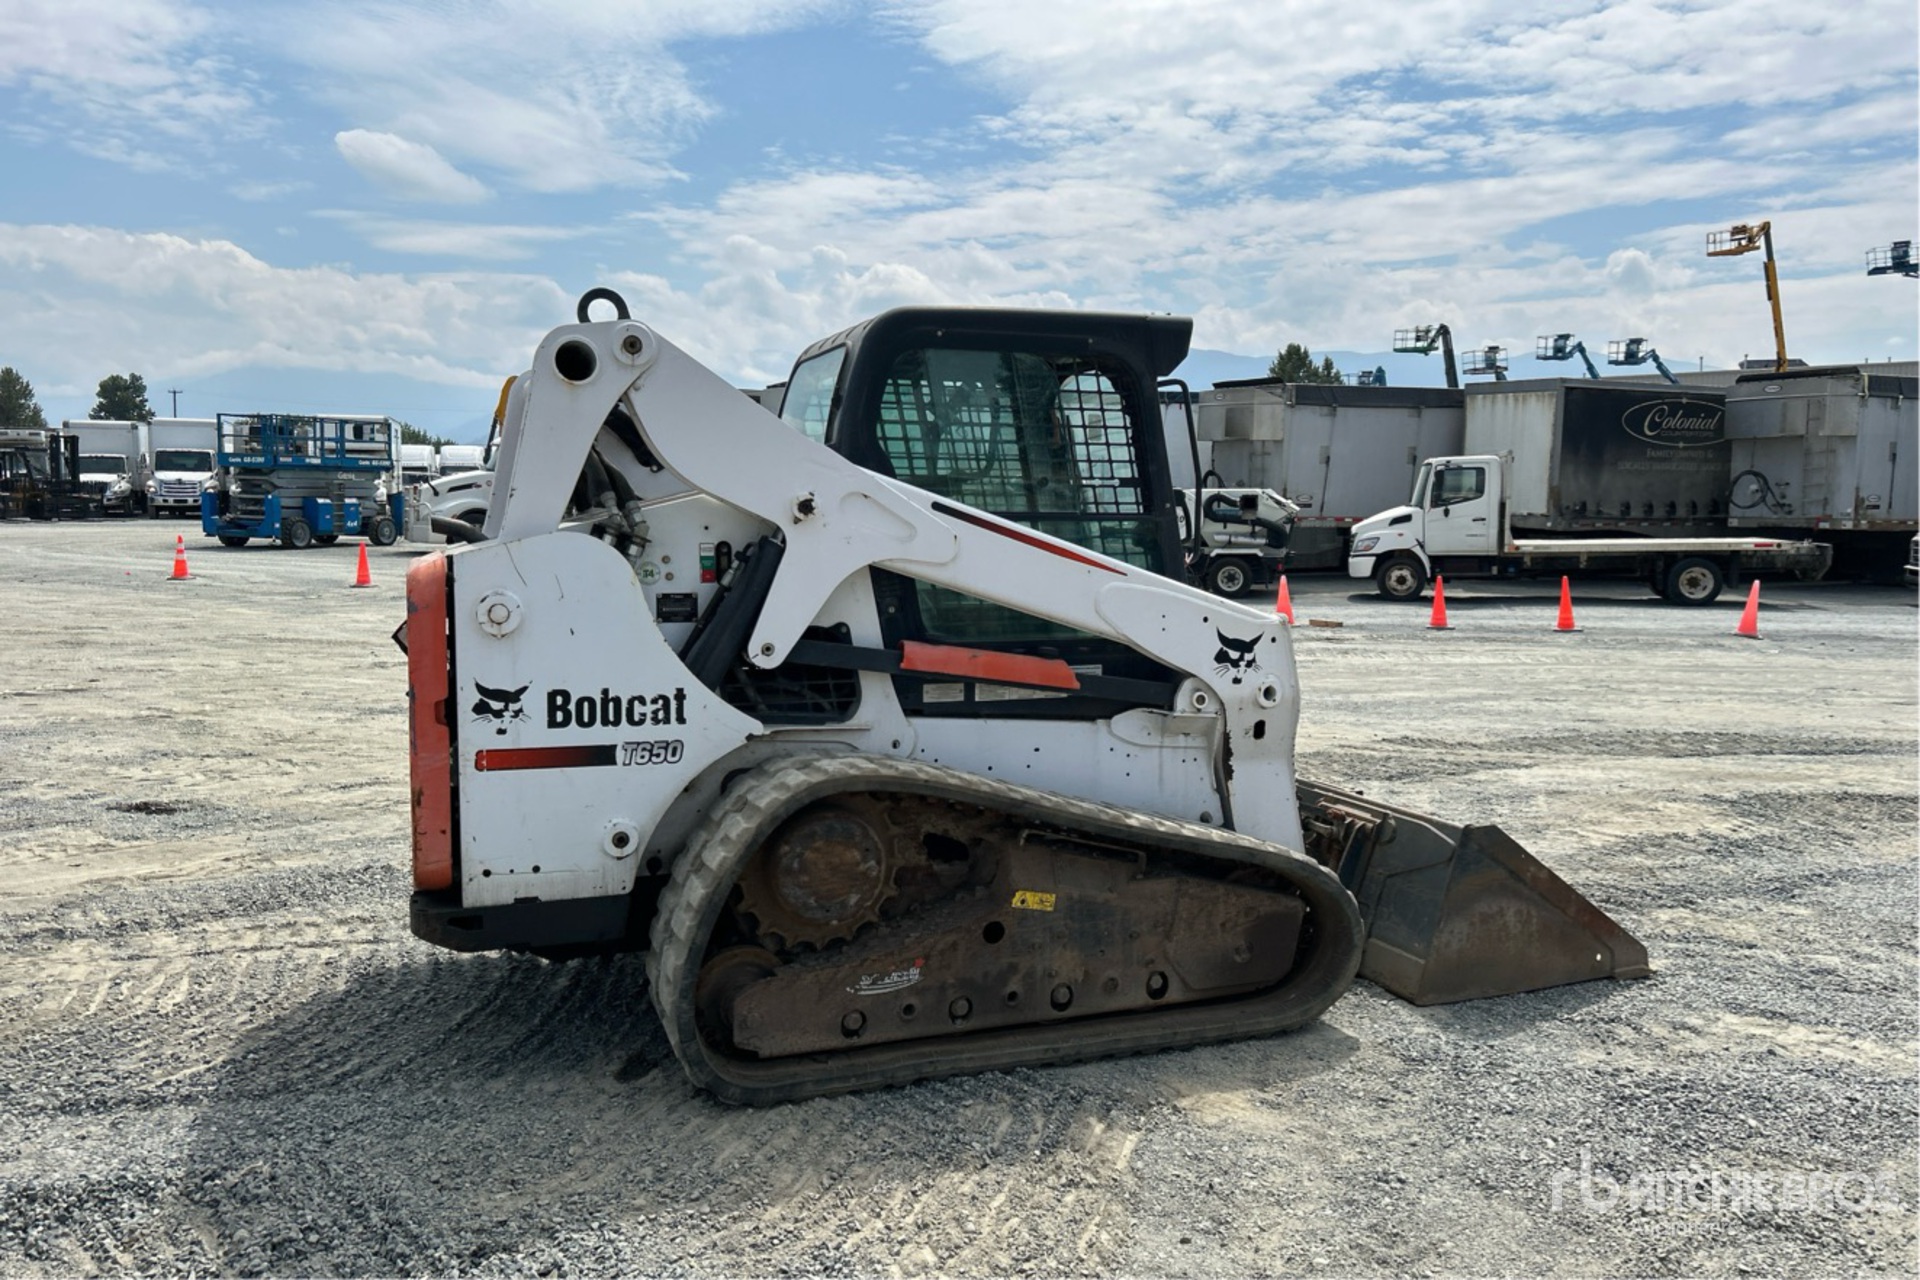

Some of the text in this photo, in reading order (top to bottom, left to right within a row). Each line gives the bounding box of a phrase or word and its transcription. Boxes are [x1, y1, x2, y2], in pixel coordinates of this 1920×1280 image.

[1644, 405, 1722, 436] Colonial
[547, 687, 687, 729] Bobcat
[622, 740, 684, 766] T650
